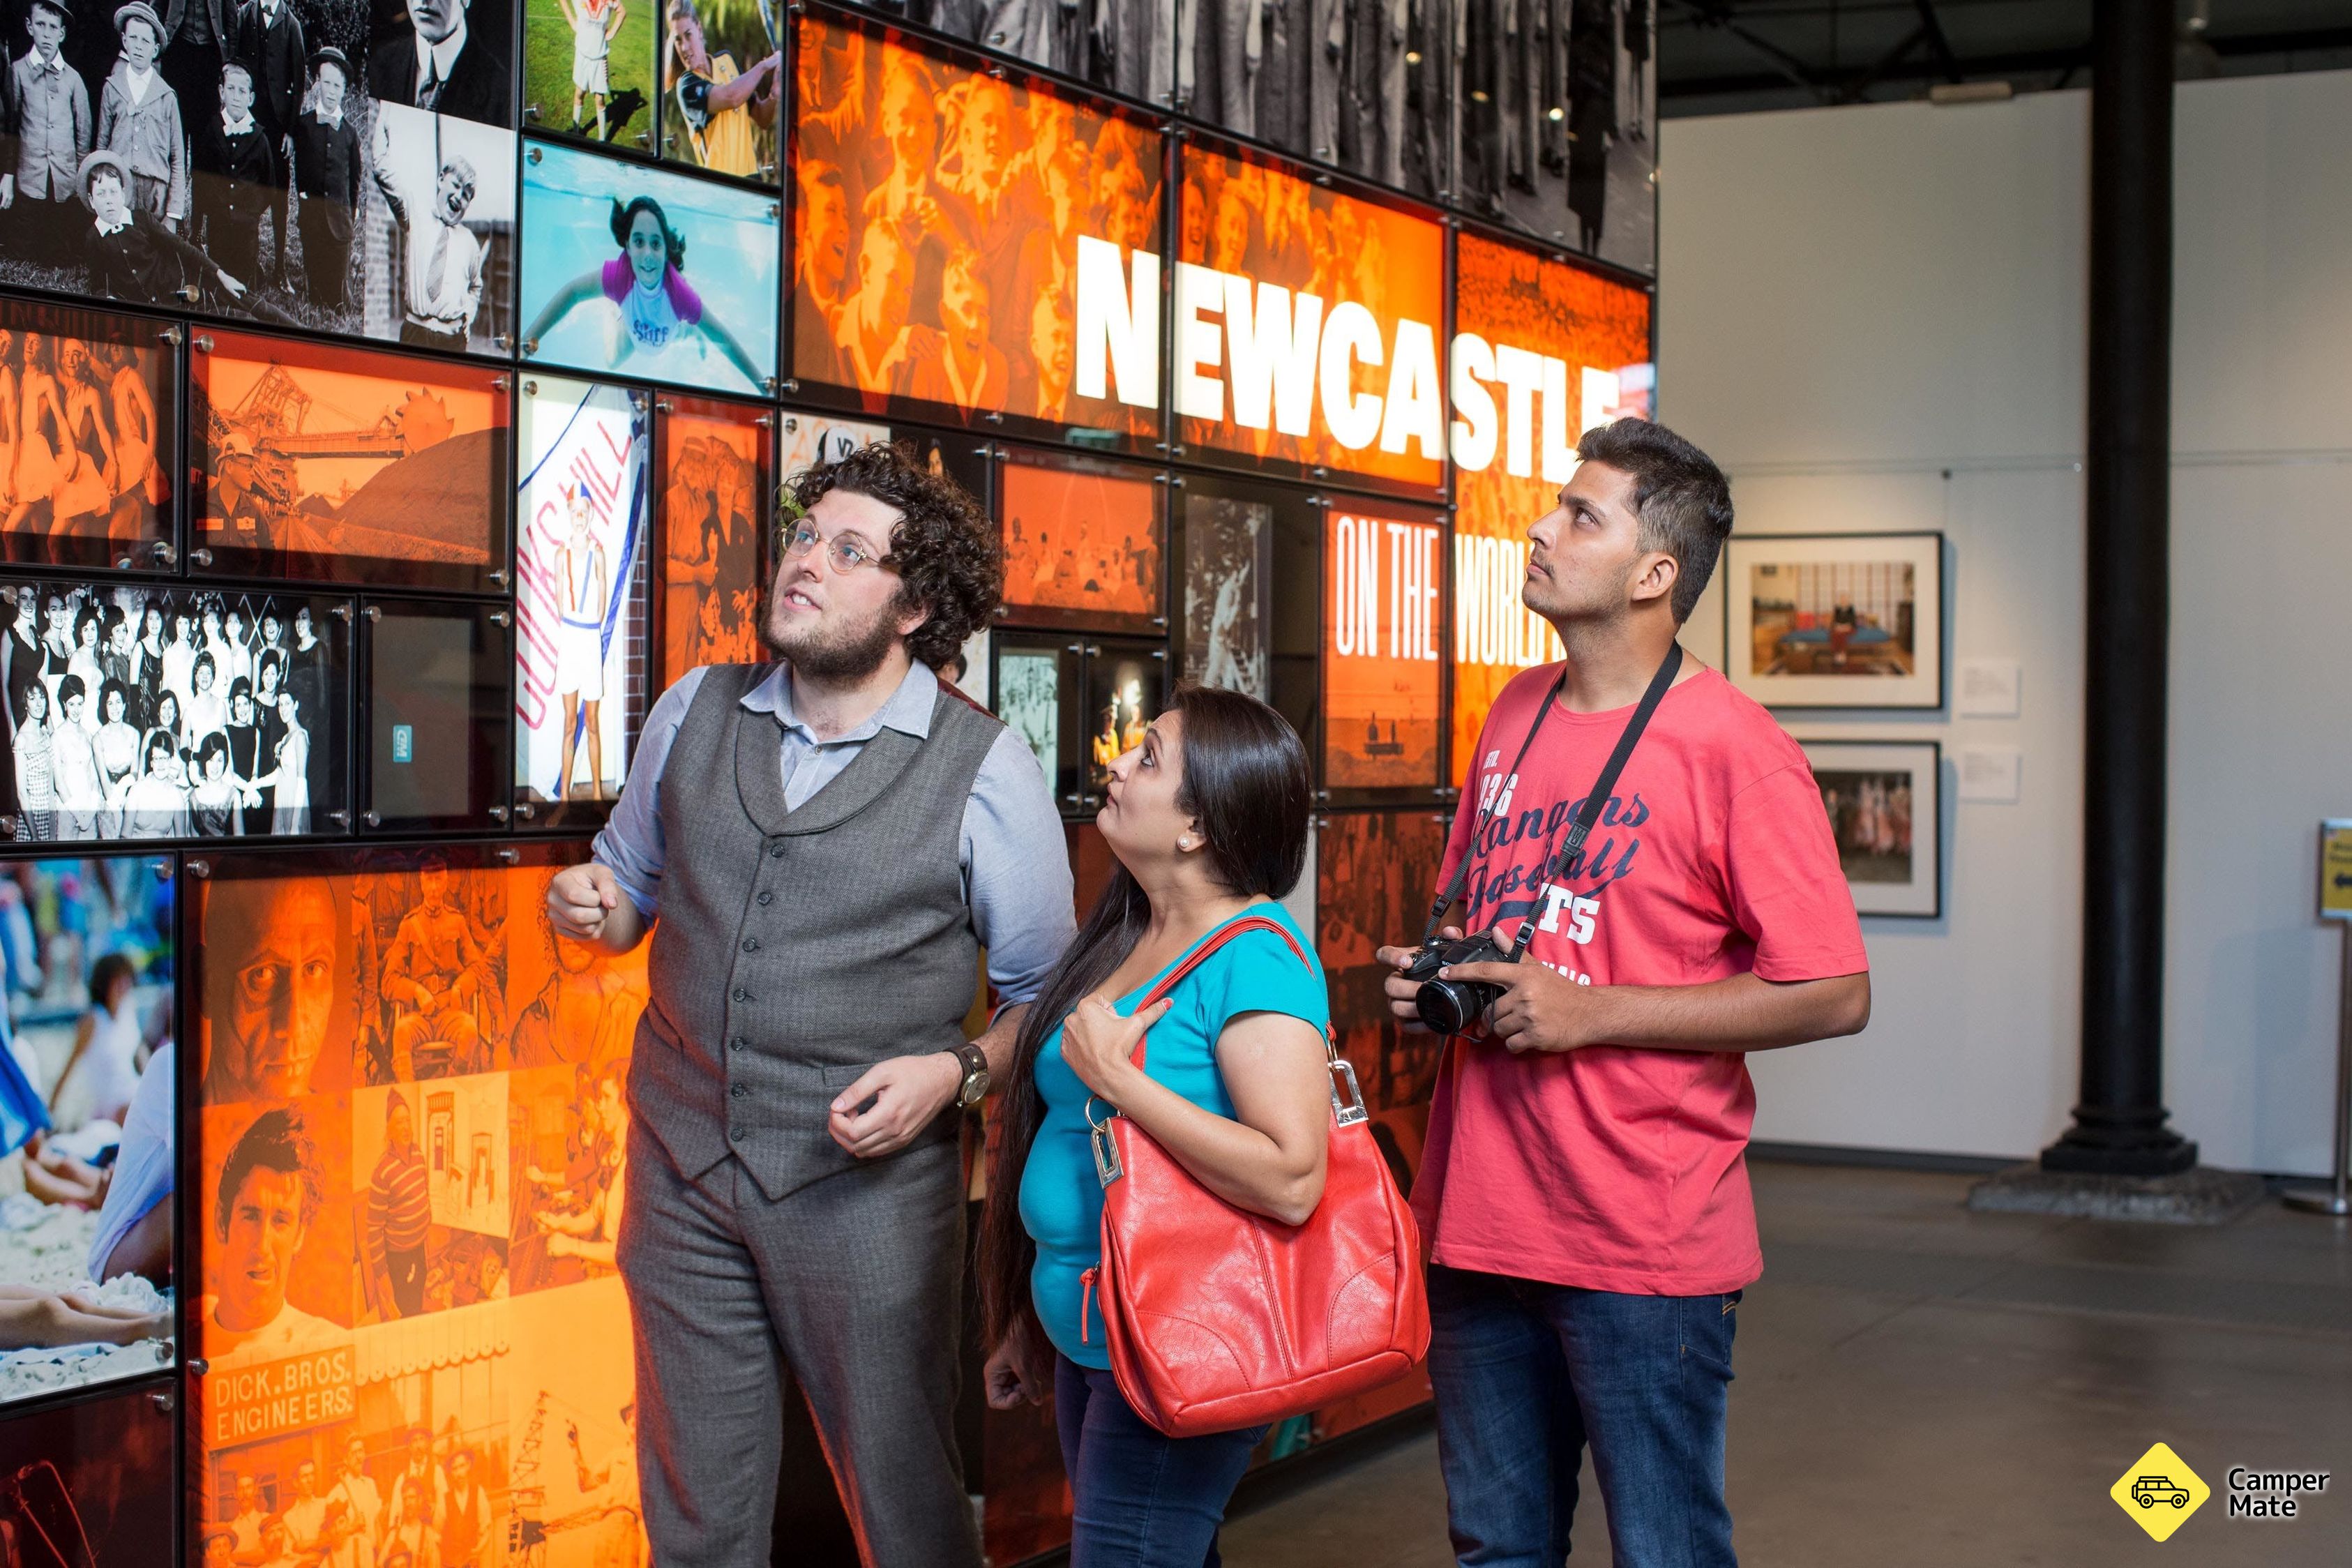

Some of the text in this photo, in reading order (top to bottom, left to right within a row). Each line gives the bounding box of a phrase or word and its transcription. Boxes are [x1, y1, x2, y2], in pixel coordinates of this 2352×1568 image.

[1336, 515, 1378, 657] ON
[1387, 522, 1438, 661] THE
[1477, 773, 1518, 817] 936
